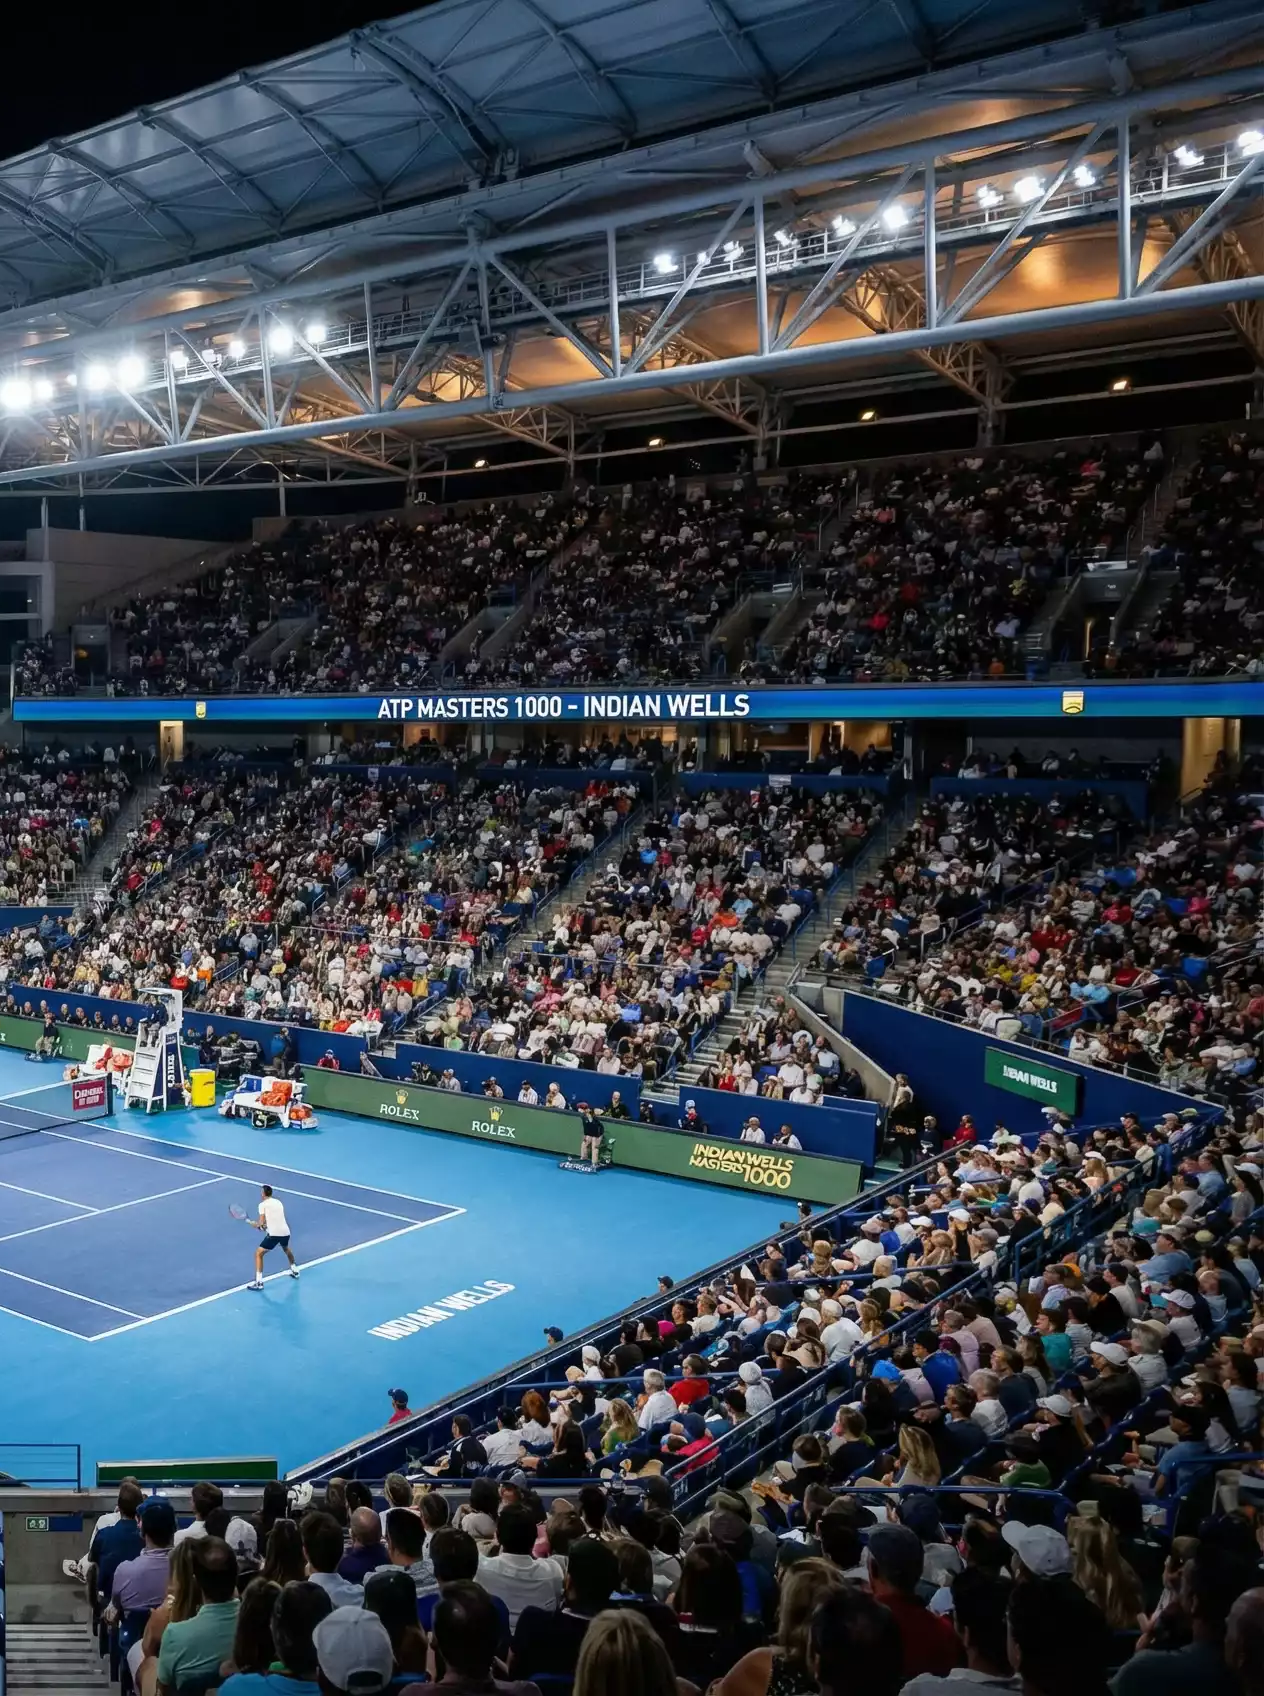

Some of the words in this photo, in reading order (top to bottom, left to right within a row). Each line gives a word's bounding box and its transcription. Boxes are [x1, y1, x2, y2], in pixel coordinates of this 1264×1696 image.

[377, 699, 413, 718] ATP
[417, 697, 509, 718] MASTERS
[514, 696, 562, 718] 1000
[584, 695, 661, 717] INDIAN
[666, 694, 750, 717] WELLS
[379, 1103, 420, 1121] ROLEX
[472, 1120, 516, 1138] ROLEX
[693, 1143, 746, 1163] INDIAN
[746, 1152, 794, 1171] WELLS
[742, 1164, 791, 1189] 1000
[366, 1305, 456, 1341] INDIAN
[434, 1279, 516, 1311] WELLS
